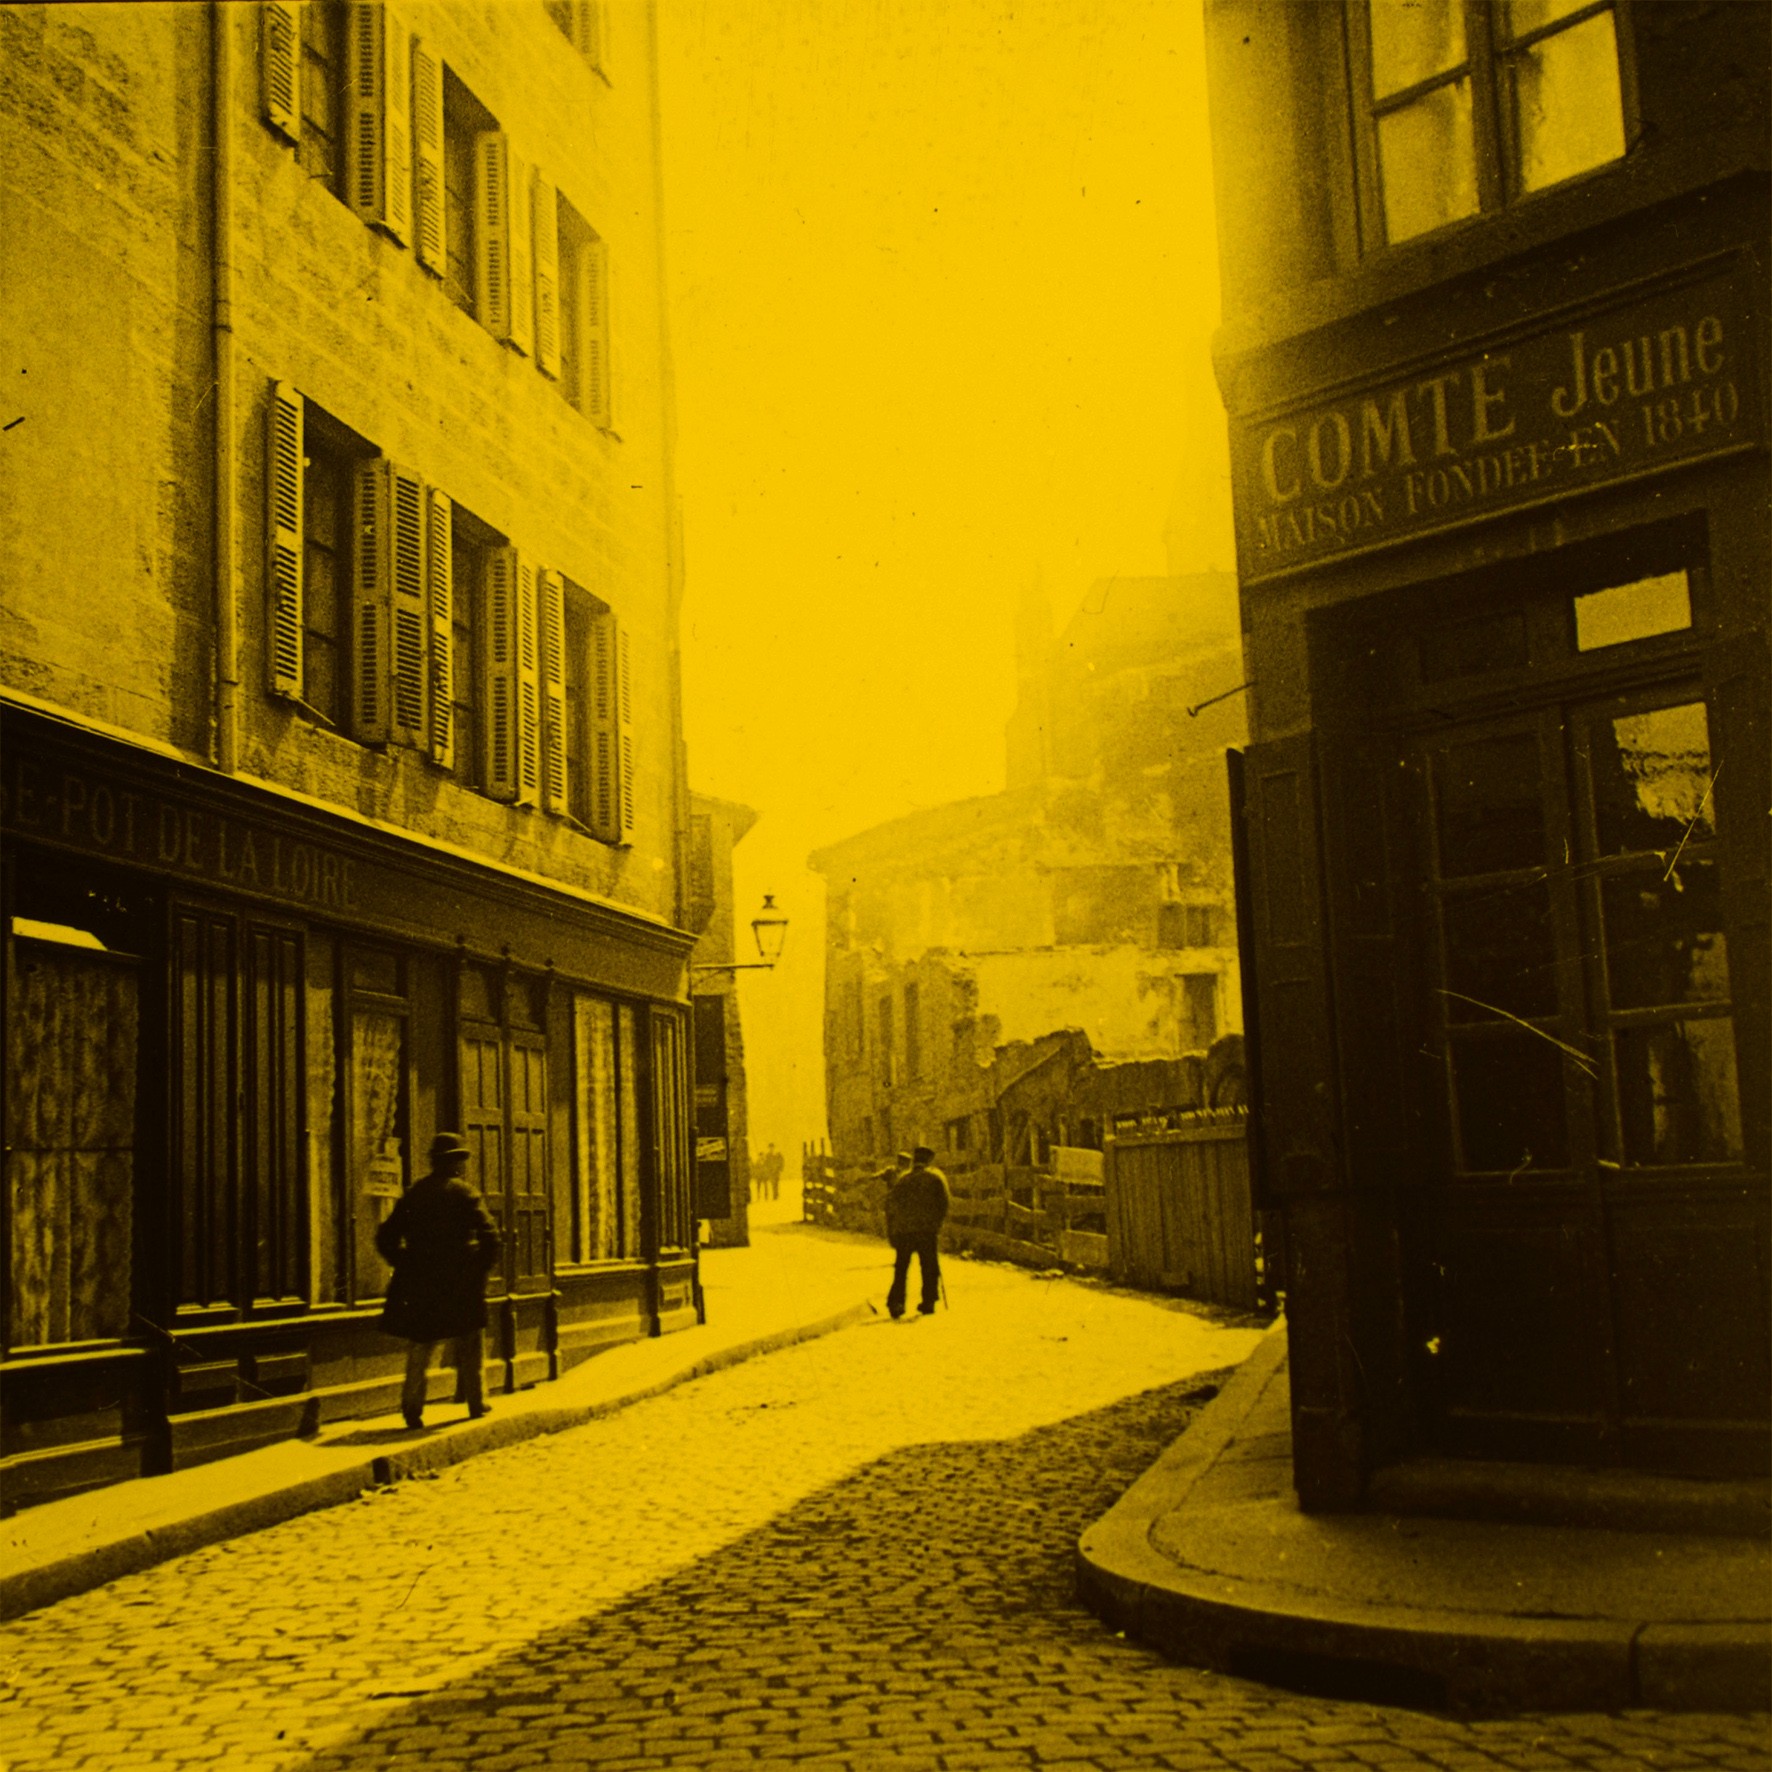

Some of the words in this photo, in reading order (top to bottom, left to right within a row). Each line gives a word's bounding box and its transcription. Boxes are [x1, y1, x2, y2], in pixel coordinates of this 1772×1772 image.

[1257, 486, 1386, 552] MAISON
[1568, 421, 1622, 471] EN
[1640, 381, 1741, 448] 1840
[1261, 355, 1517, 504] COMTE
[1551, 314, 1725, 418] Jeune
[157, 802, 204, 870] DE
[216, 819, 260, 884] LA
[270, 836, 362, 911] LOIRE
